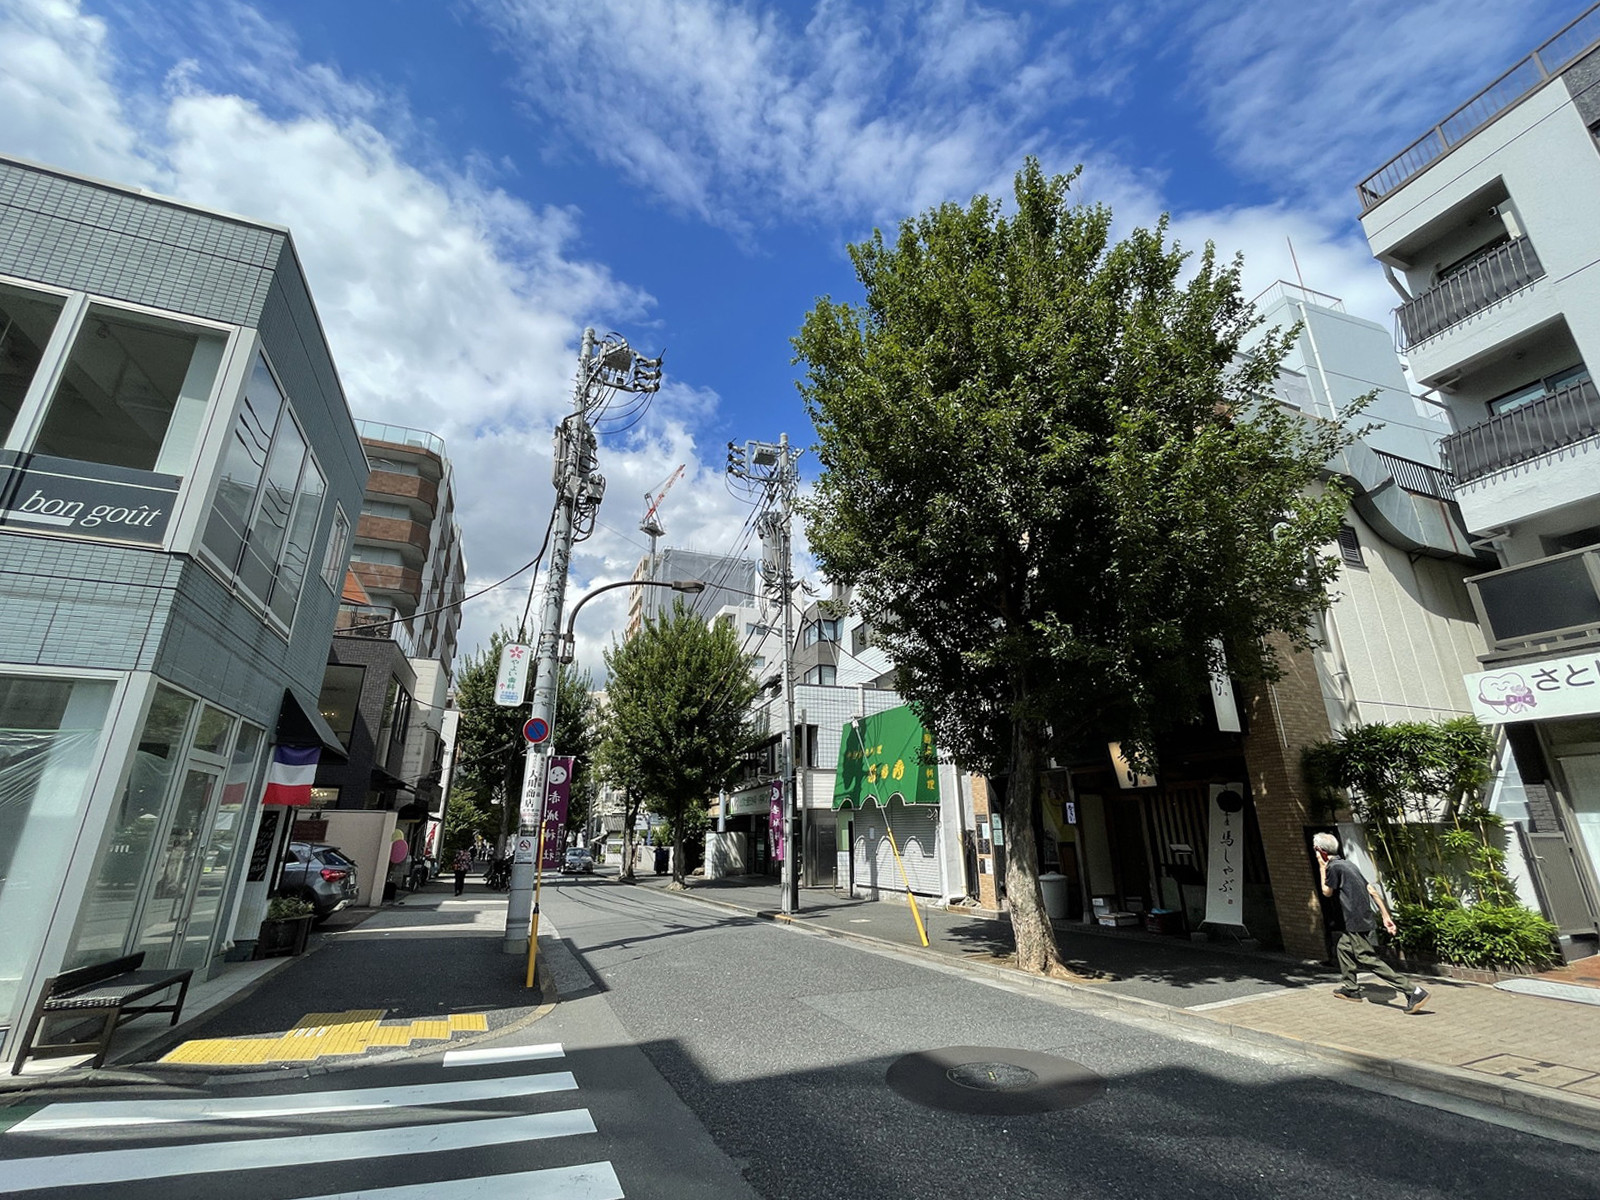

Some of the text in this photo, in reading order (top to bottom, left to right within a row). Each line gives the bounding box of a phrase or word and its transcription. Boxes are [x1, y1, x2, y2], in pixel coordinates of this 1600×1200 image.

[19, 490, 163, 528] bon goût
[1531, 659, 1600, 691] さと
